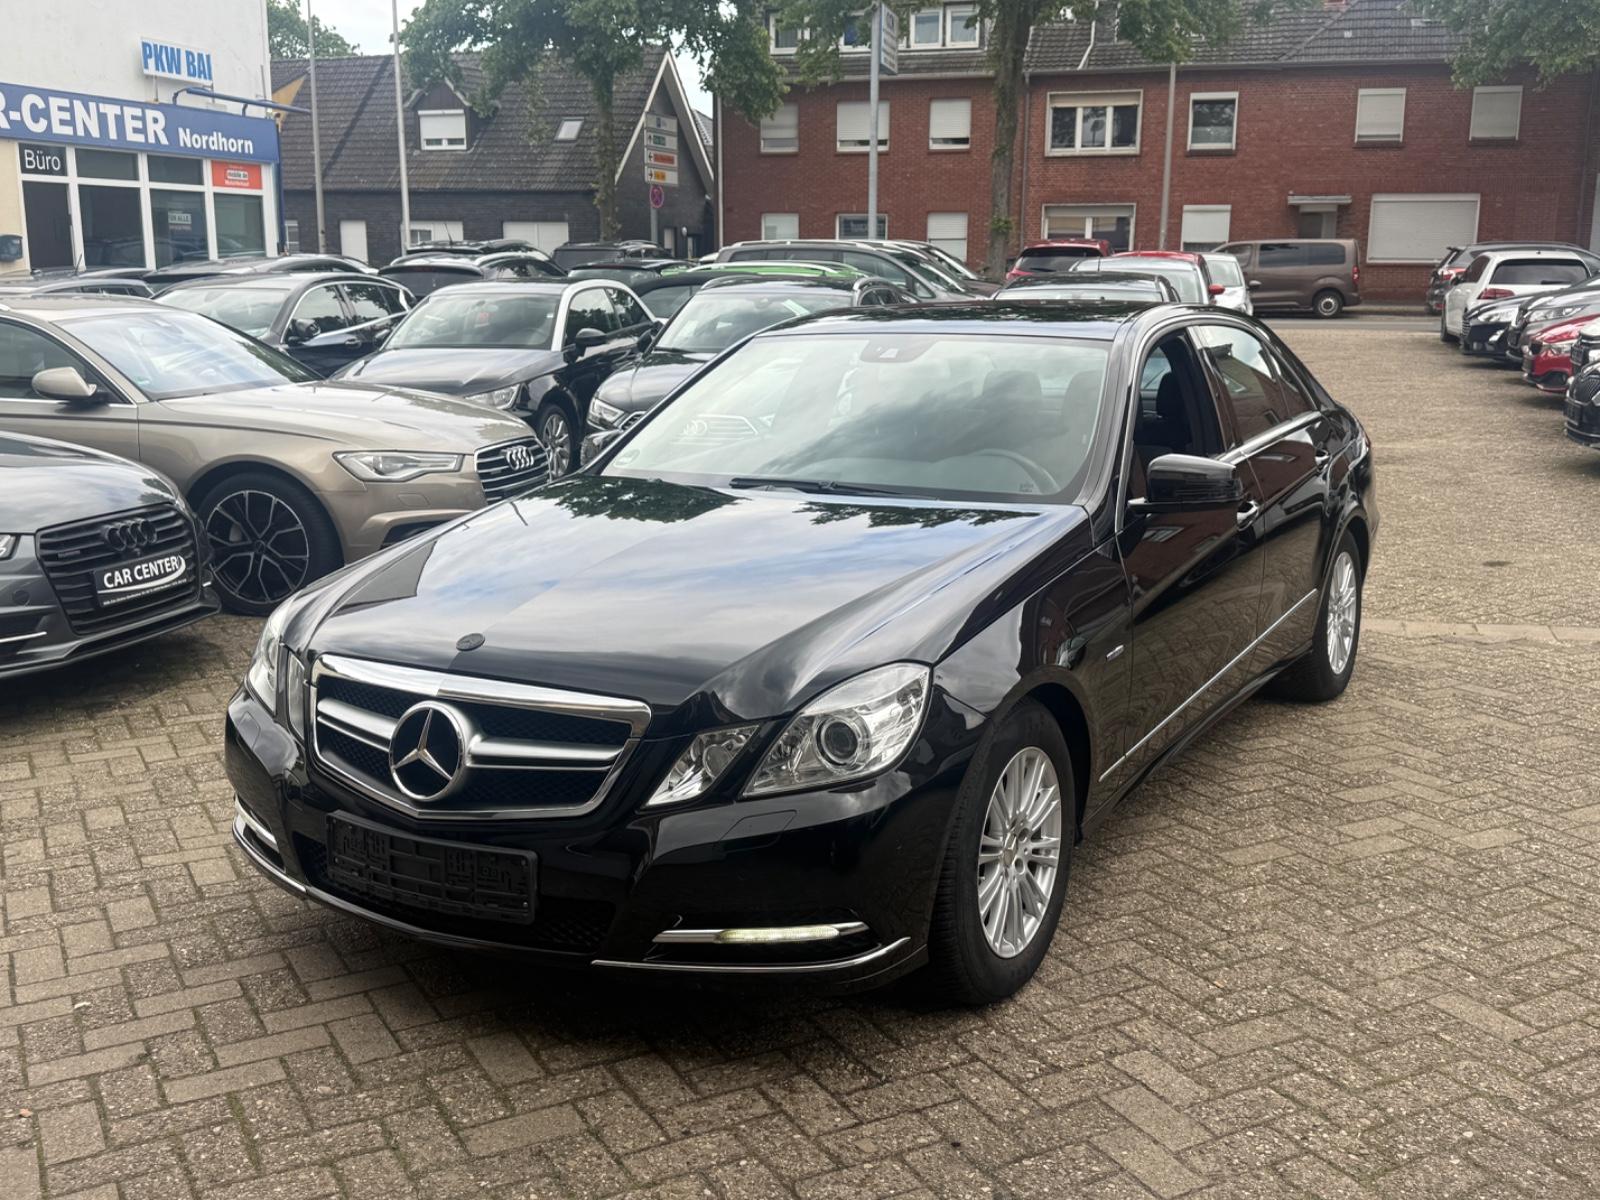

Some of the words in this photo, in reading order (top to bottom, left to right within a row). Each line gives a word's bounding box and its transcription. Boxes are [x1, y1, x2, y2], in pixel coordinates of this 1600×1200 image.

[142, 41, 182, 75] PKW
[178, 127, 253, 155] Nordhorn
[24, 149, 61, 171] Büro
[103, 568, 133, 588] CAR
[134, 556, 179, 580] CENTER
